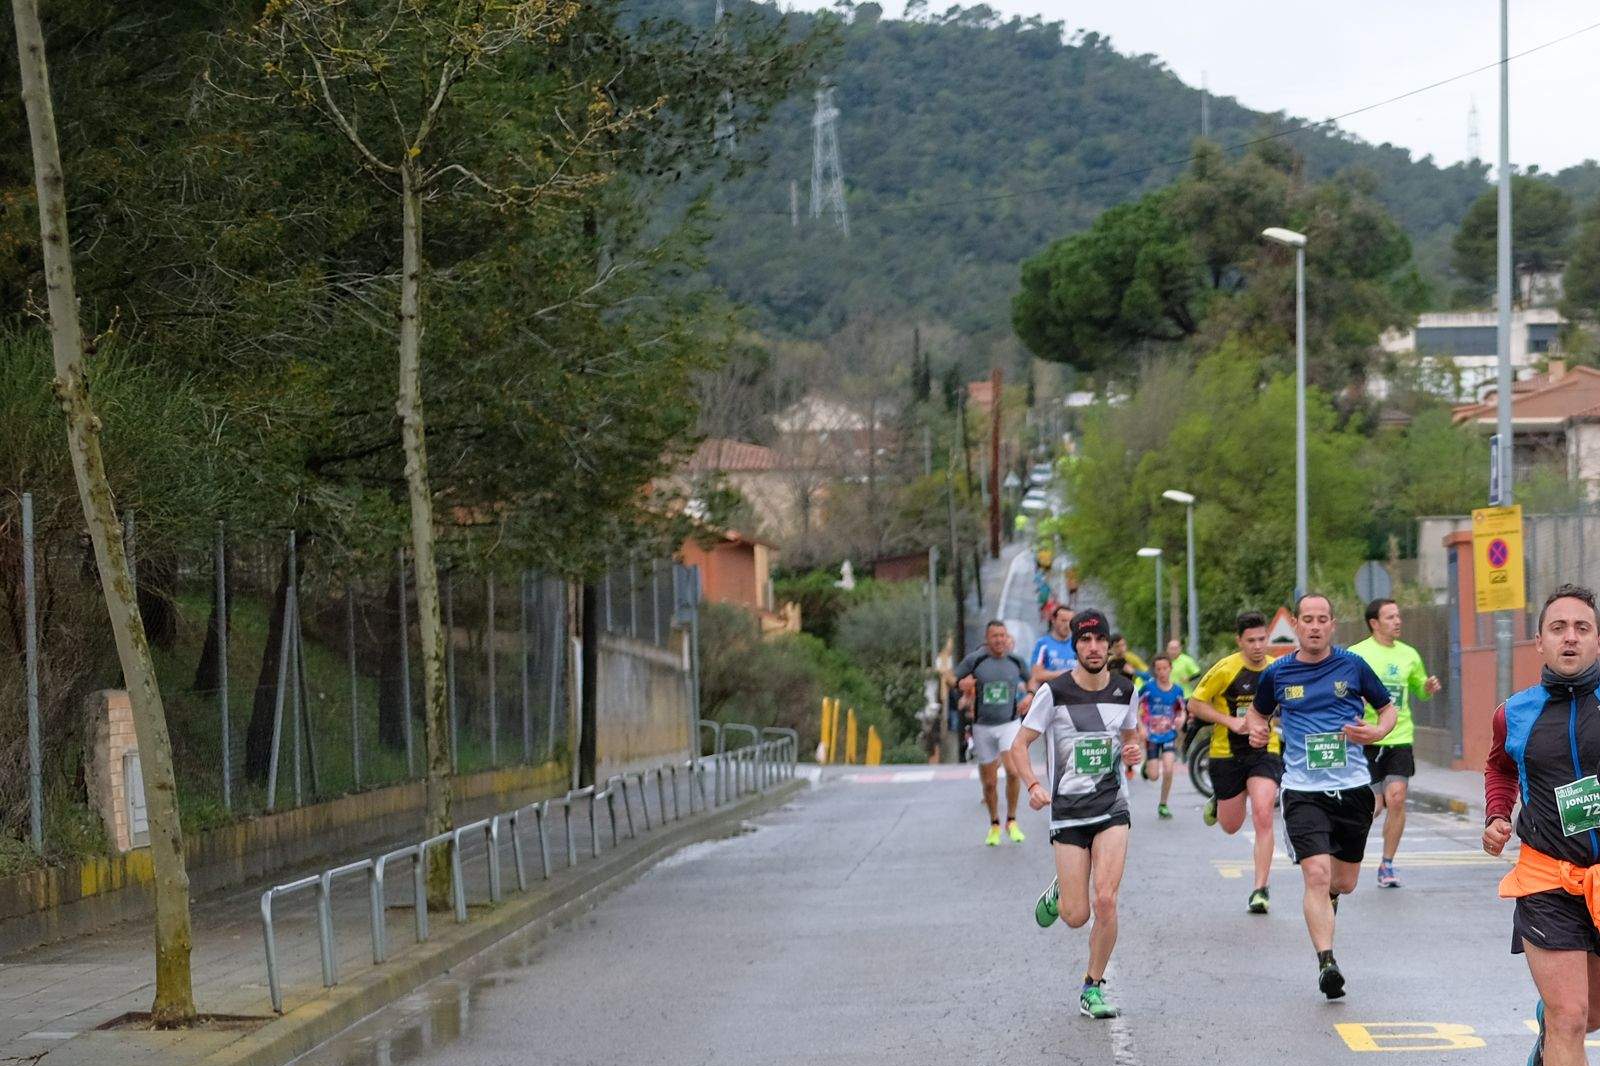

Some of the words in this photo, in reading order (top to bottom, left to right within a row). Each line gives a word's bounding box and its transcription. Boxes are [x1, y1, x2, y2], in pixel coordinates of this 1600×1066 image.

[1313, 743, 1340, 751] ARNAU
[1321, 750, 1335, 760] 32
[1089, 755, 1102, 766] 23
